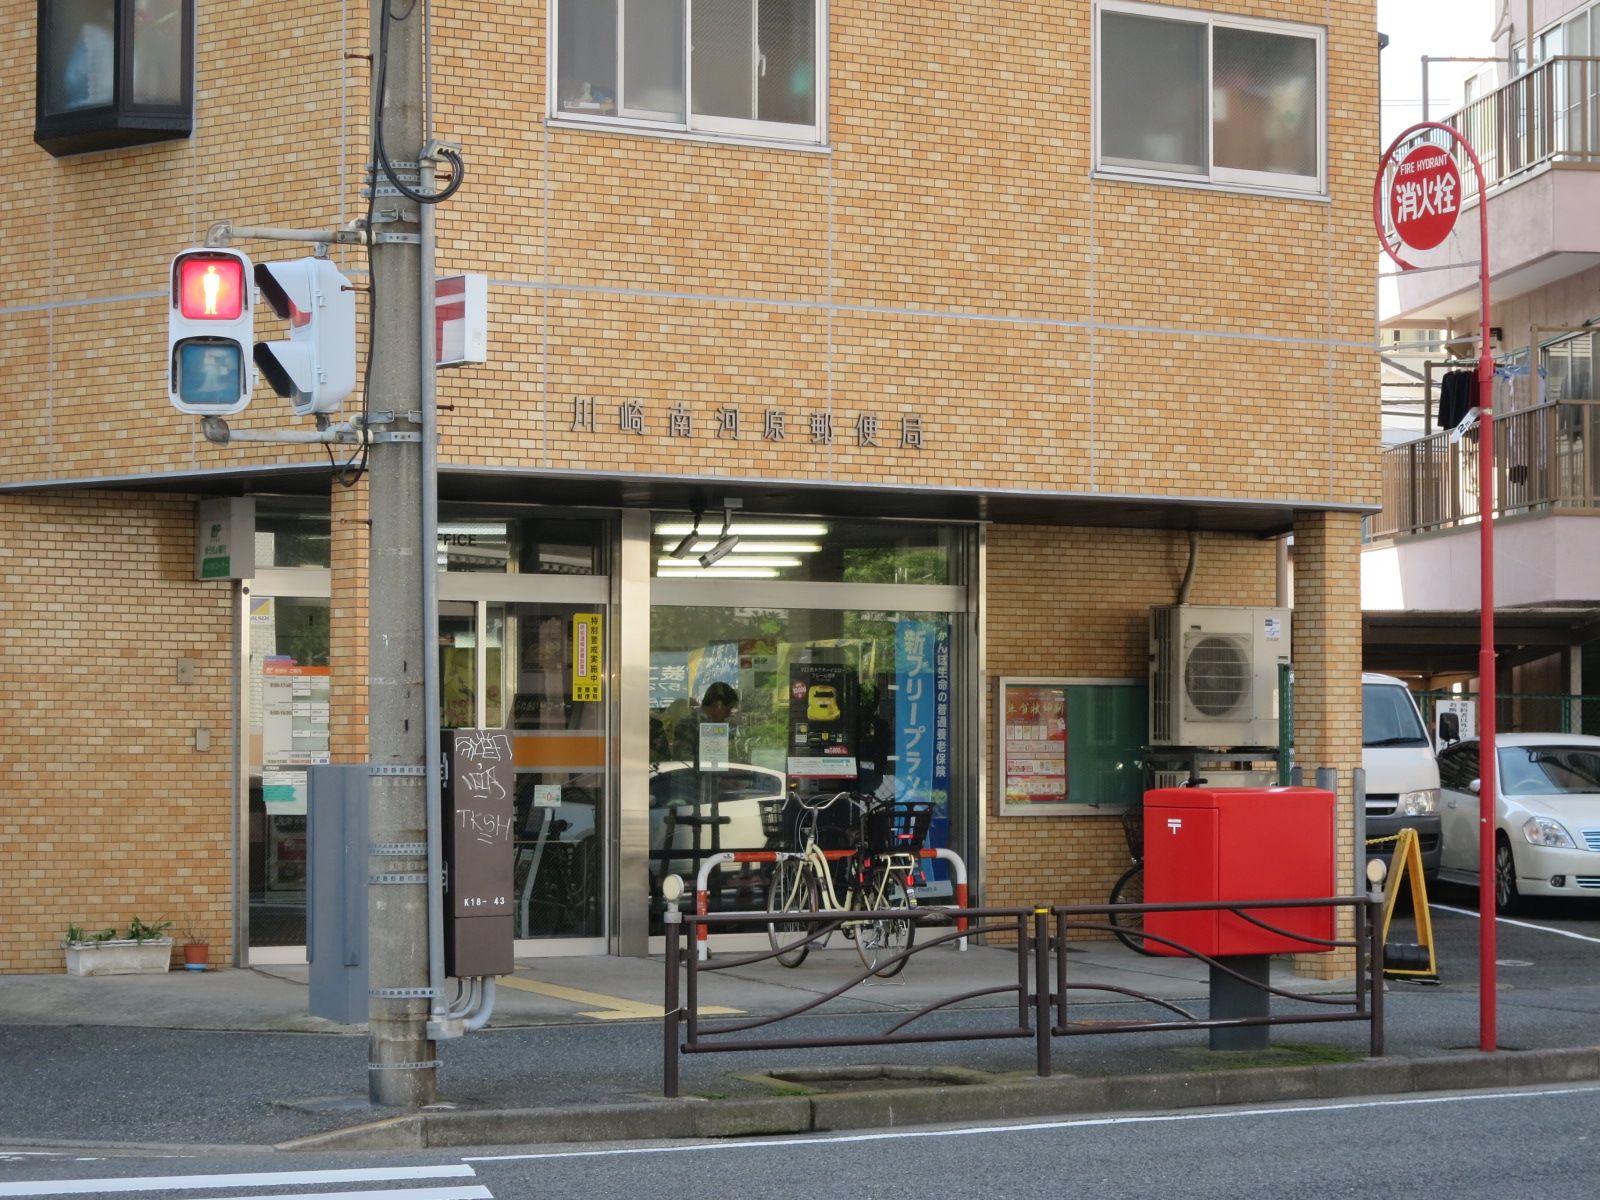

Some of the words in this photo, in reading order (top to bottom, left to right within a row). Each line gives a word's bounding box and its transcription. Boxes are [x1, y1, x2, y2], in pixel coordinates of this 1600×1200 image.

[1400, 161, 1415, 175] FIRE
[1417, 154, 1448, 171] HYDRANT
[1396, 172, 1456, 223] 消火栓
[571, 396, 924, 449] 川崎南河原郵便局
